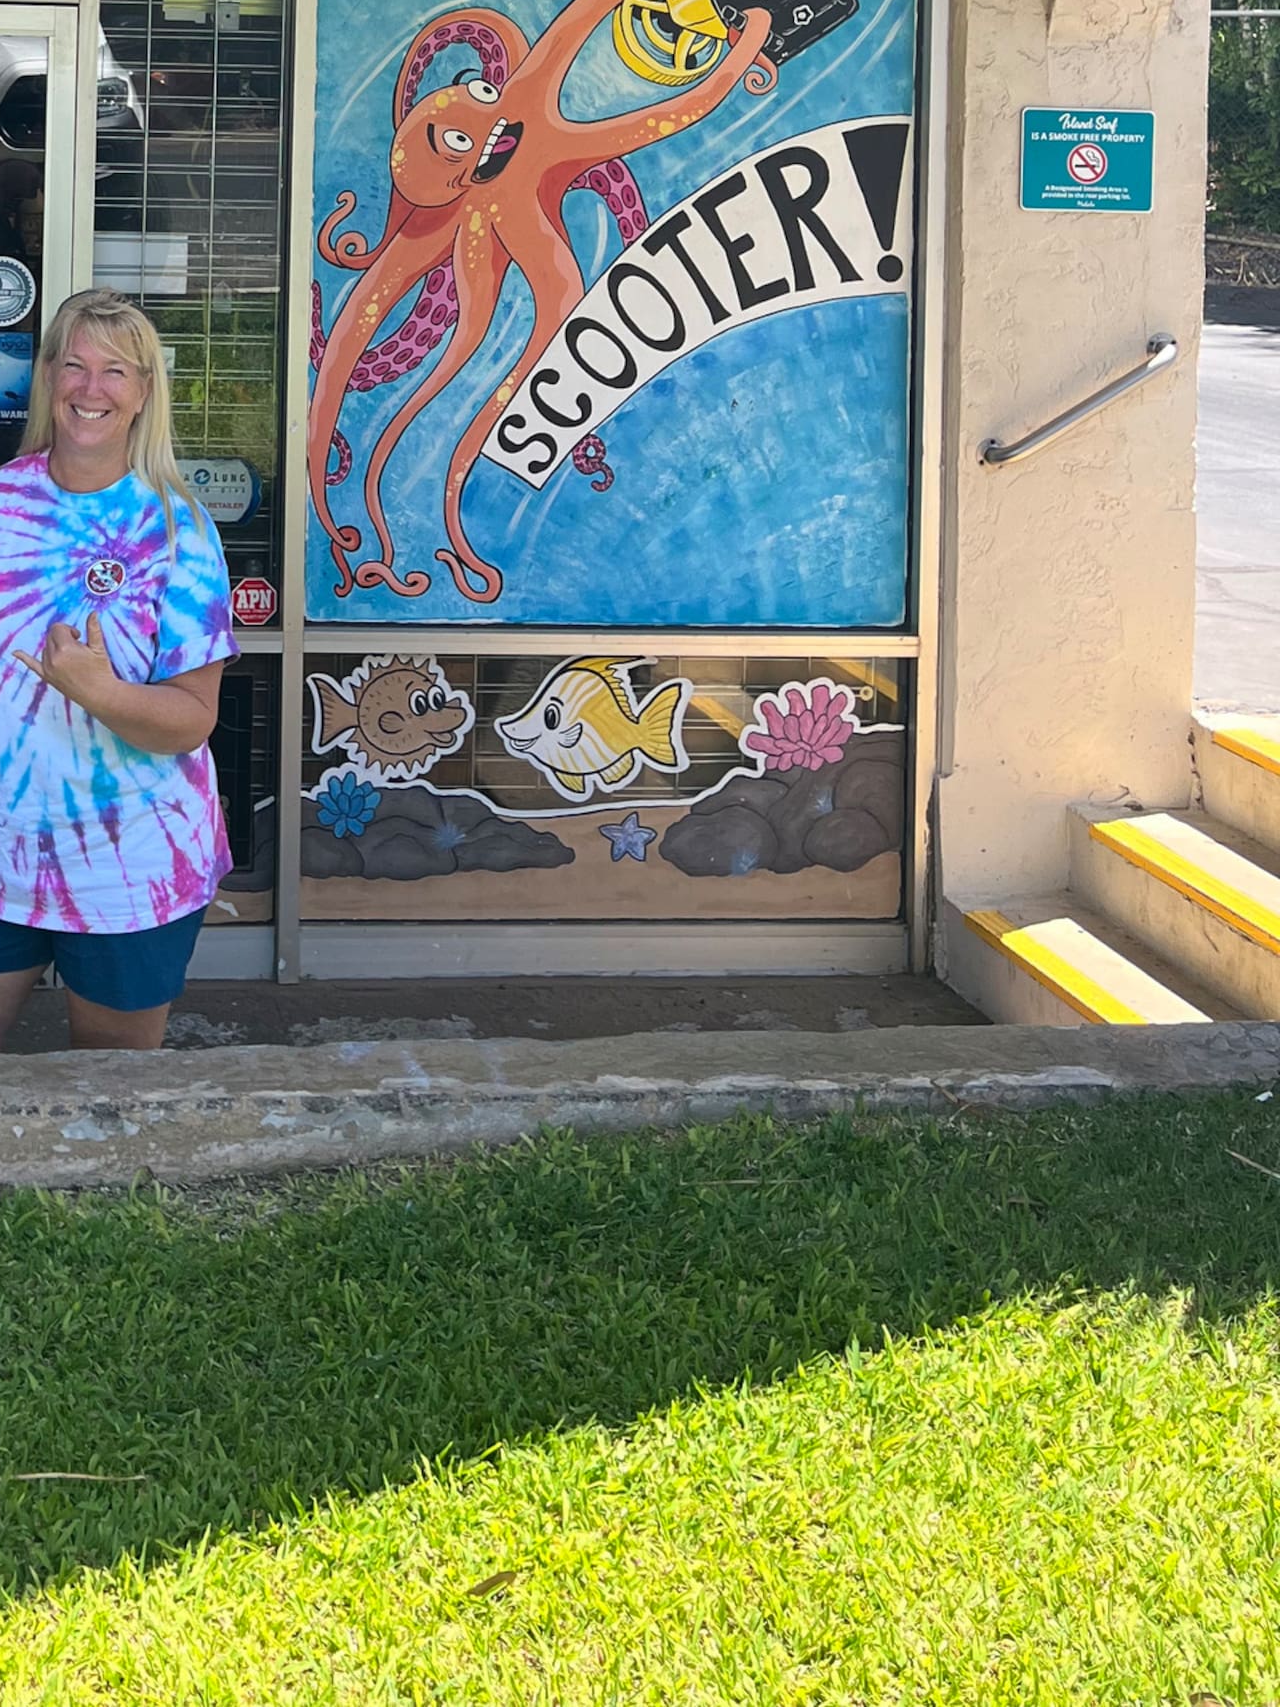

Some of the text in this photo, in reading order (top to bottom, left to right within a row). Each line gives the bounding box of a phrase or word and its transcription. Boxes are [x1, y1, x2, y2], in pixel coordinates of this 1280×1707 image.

[1058, 113, 1119, 135] Island Surf
[1031, 132, 1145, 143] IS A SMOKE FREE PROPERTY
[497, 123, 910, 474] SCOOTER!
[213, 473, 246, 482] LUNG
[236, 589, 272, 609] APN
